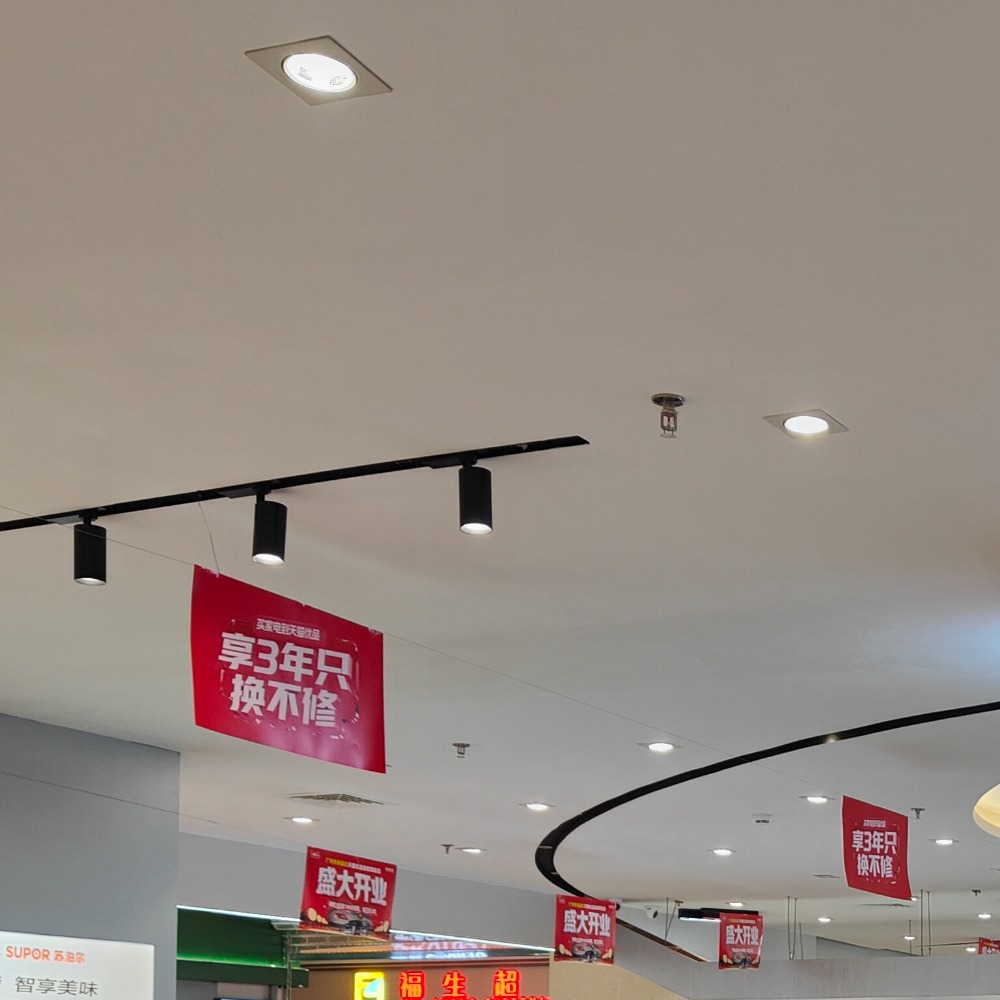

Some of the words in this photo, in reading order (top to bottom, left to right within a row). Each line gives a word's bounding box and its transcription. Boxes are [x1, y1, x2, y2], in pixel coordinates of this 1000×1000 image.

[218, 632, 351, 690] 享3年只
[230, 674, 338, 727] 换不修
[852, 829, 898, 854] 享3年只
[857, 853, 893, 878] 换不修
[315, 866, 388, 906] 盛大开业
[563, 908, 611, 937] 盛大开业
[725, 924, 759, 946] 盛大开业
[6, 945, 50, 960] SUPOR
[15, 976, 99, 997] 智享美味
[400, 969, 520, 998] 福生超
